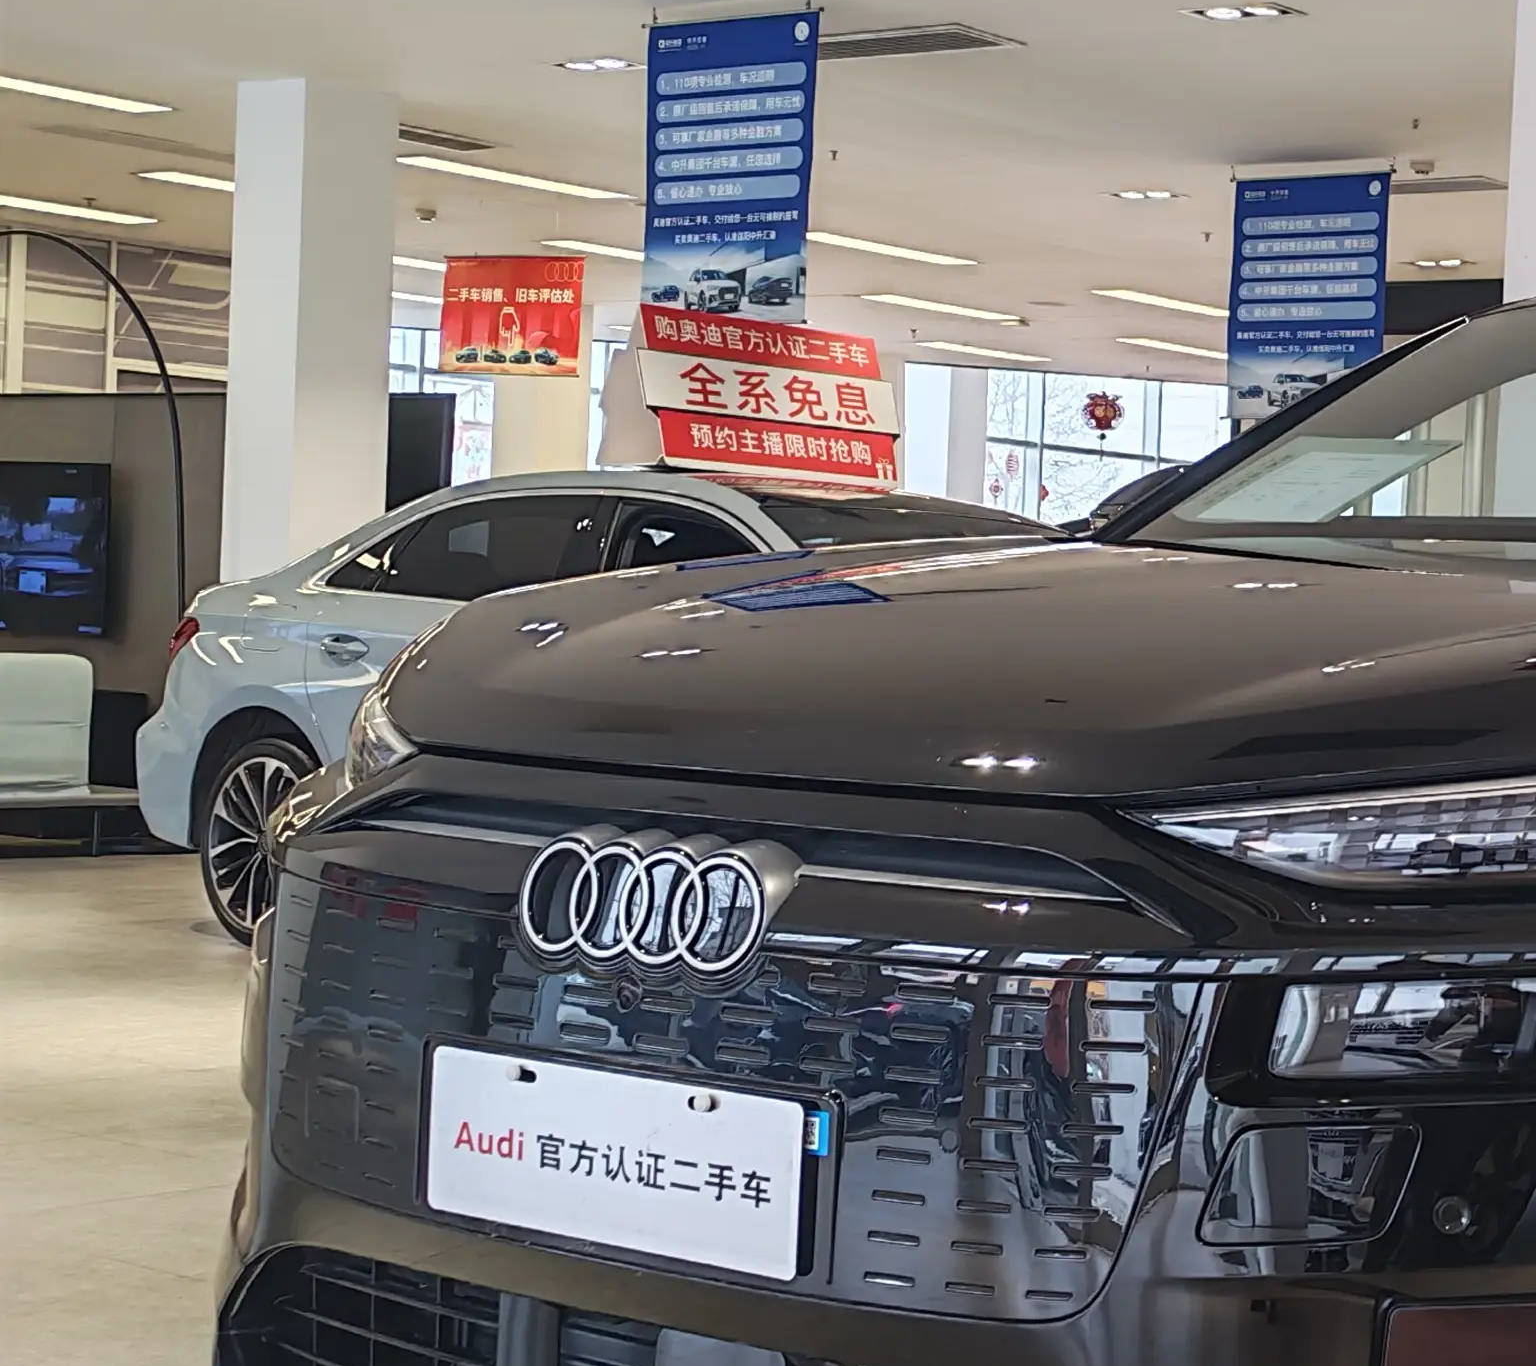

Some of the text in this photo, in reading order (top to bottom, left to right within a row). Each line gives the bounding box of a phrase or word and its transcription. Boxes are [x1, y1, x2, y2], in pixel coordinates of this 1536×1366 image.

[447, 287, 575, 304] 二手车销售、旧车评估处
[654, 315, 871, 368] 购奥迪官方认证二手车
[680, 362, 876, 426] 全系免息
[690, 422, 873, 466] 预约主播限时抢购
[454, 1121, 772, 1209] Audi 官方认证二手车
